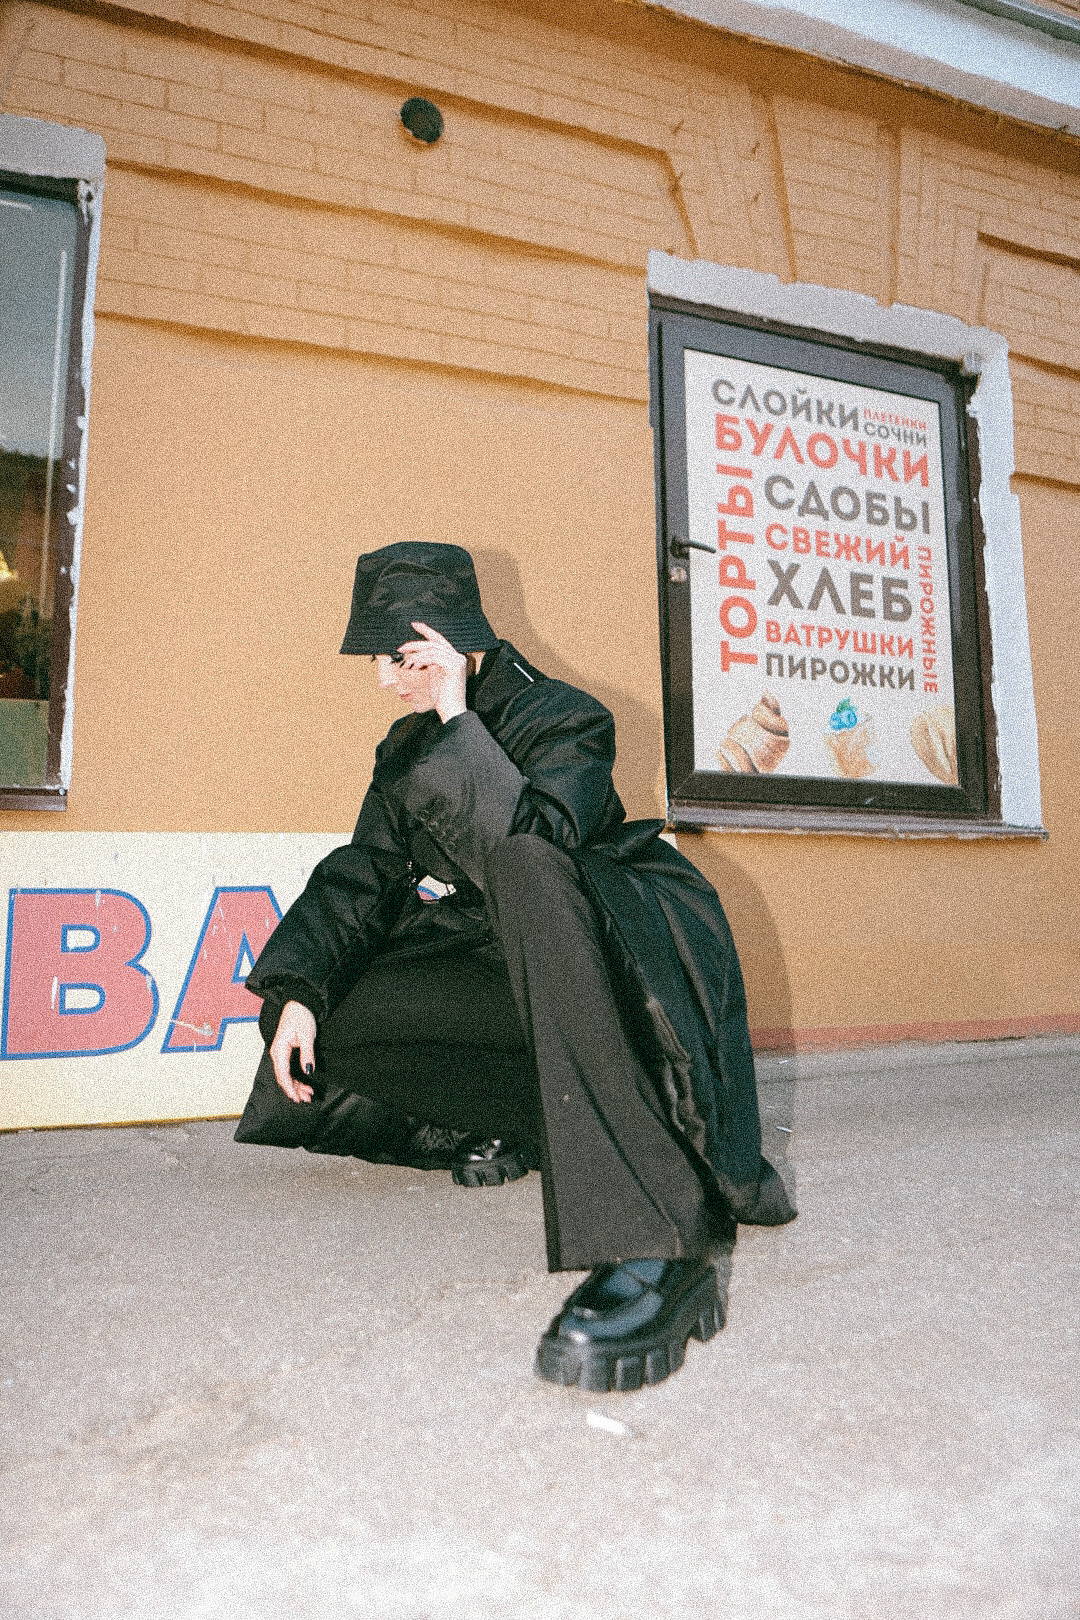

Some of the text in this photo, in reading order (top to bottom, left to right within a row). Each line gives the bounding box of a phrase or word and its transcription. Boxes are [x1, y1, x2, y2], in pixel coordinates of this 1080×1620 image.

[712, 379, 859, 431] СЛОЙКИ
[715, 413, 929, 487] БУЛОЧКИ
[863, 422, 927, 448] СОЧНИ
[764, 475, 930, 534] СДОБЫ
[716, 465, 758, 672] ТОРТЫ
[765, 523, 910, 570] СВЕЖИЙ
[768, 559, 912, 621] ХЛЕБ
[765, 621, 914, 659] ВАТРУШКИ
[917, 547, 938, 693] ПИРОЖНЫЕ
[766, 653, 915, 691] ПИРОЖКИ
